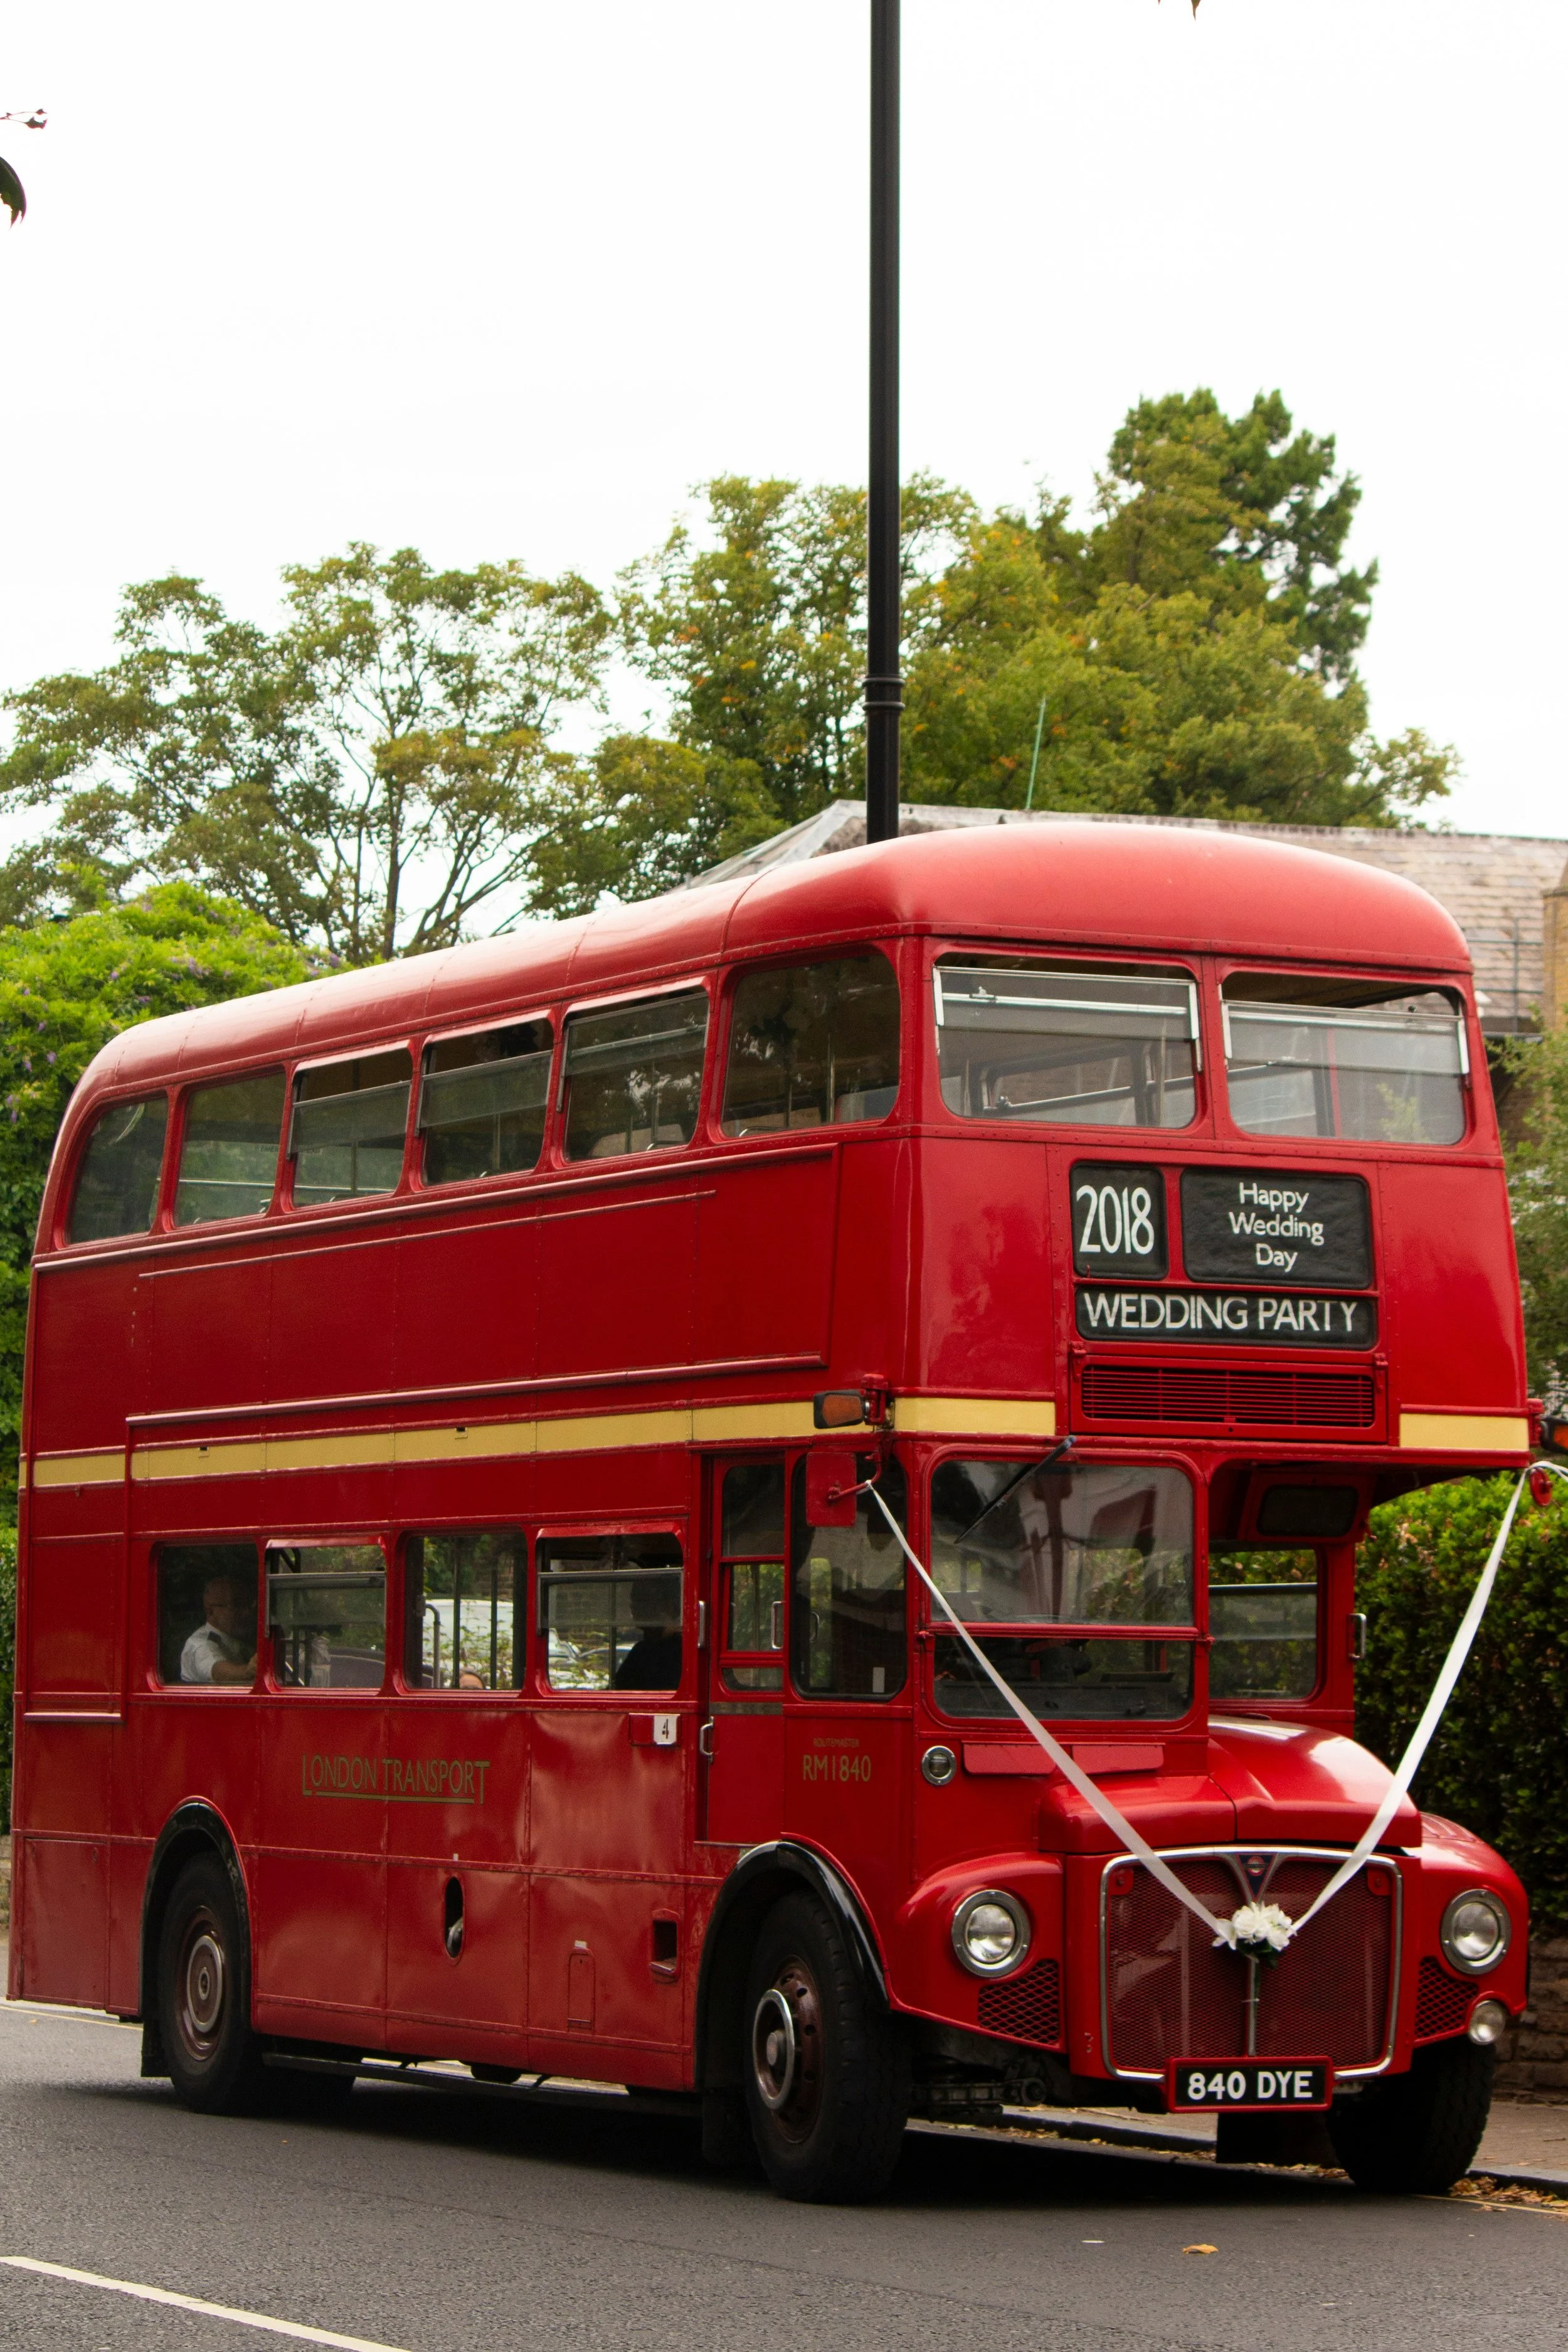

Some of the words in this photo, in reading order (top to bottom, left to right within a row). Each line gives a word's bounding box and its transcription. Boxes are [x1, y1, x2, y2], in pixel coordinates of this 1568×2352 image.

[1239, 1182, 1309, 1213] Happy
[1076, 1185, 1155, 1254] 2018
[1229, 1212, 1324, 1246] Wedding
[1256, 1243, 1298, 1273] Day
[1084, 1293, 1248, 1330] WEDDING
[1258, 1298, 1357, 1332] PARTY
[662, 1719, 669, 1739] 4
[302, 1754, 377, 1797] LONDON
[382, 1759, 490, 1804] TRANSPORT
[802, 1754, 872, 1782] RM1840
[1188, 2071, 1246, 2100] 840
[1258, 2071, 1313, 2099] DYE
